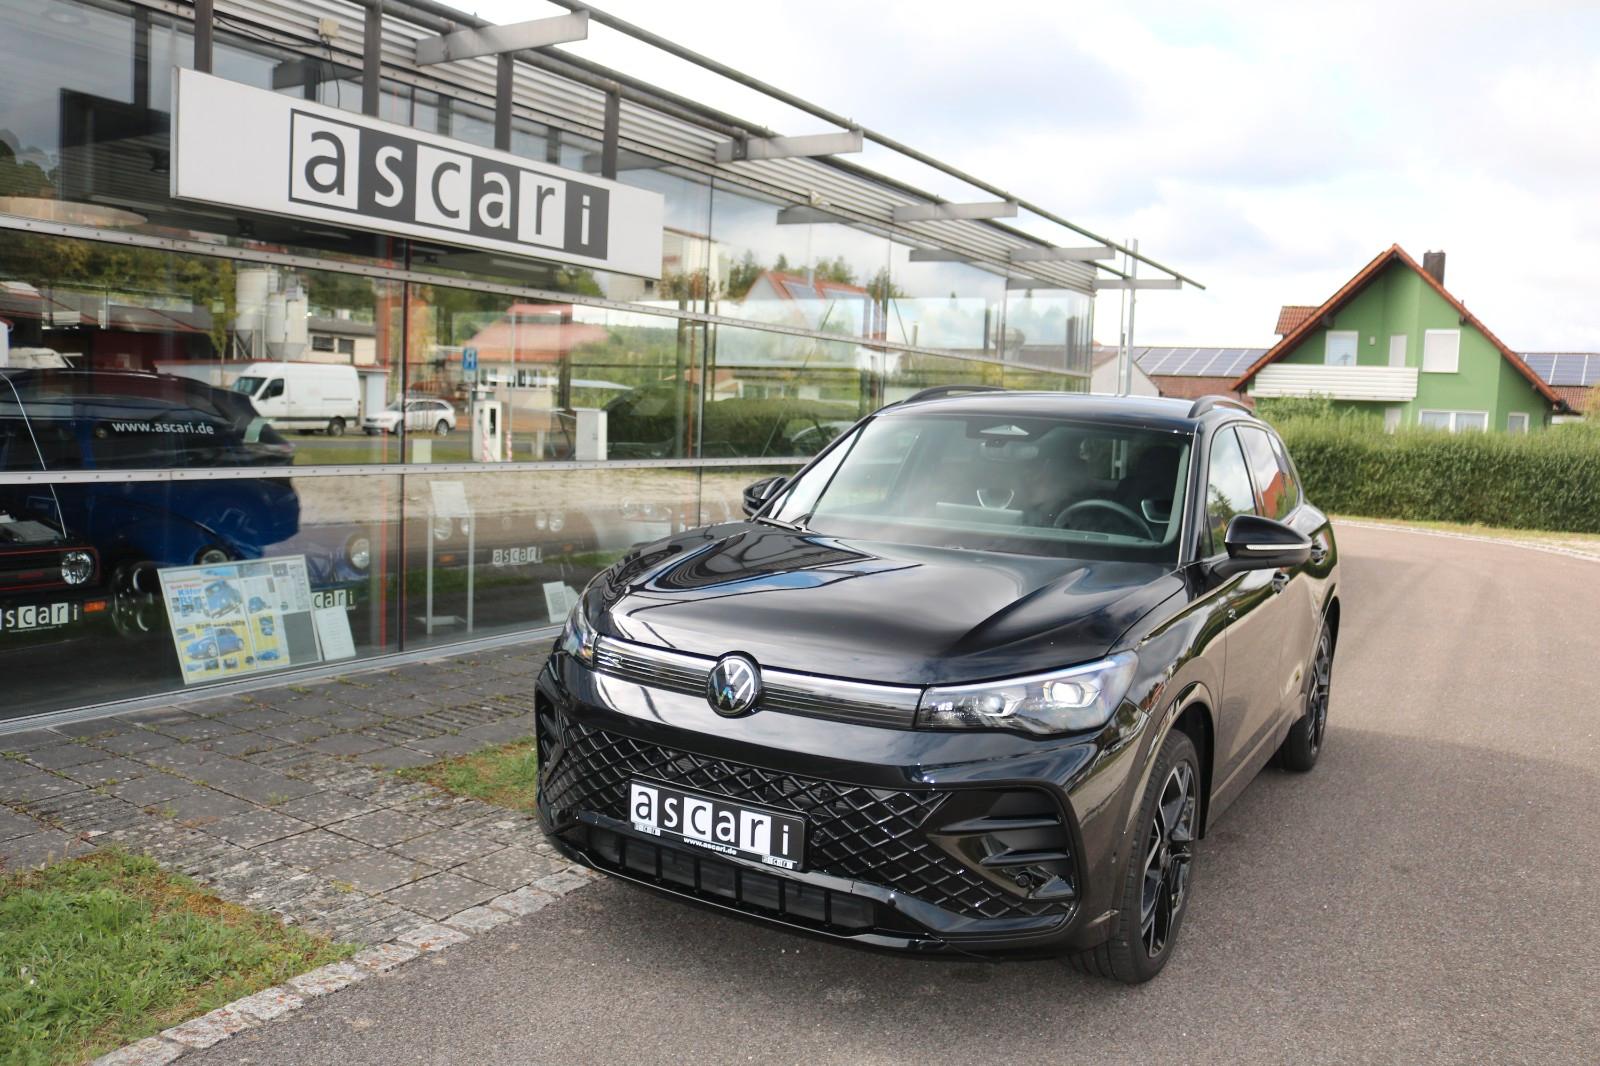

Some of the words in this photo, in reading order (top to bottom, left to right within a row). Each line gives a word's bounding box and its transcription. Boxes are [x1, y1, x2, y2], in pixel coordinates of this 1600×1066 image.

[302, 130, 592, 246] ascari
[112, 421, 214, 435] www.ascari.de
[493, 548, 542, 564] ascari
[0, 603, 78, 628] scari
[634, 790, 790, 856] ascari
[683, 837, 738, 856] www.ascari.de
